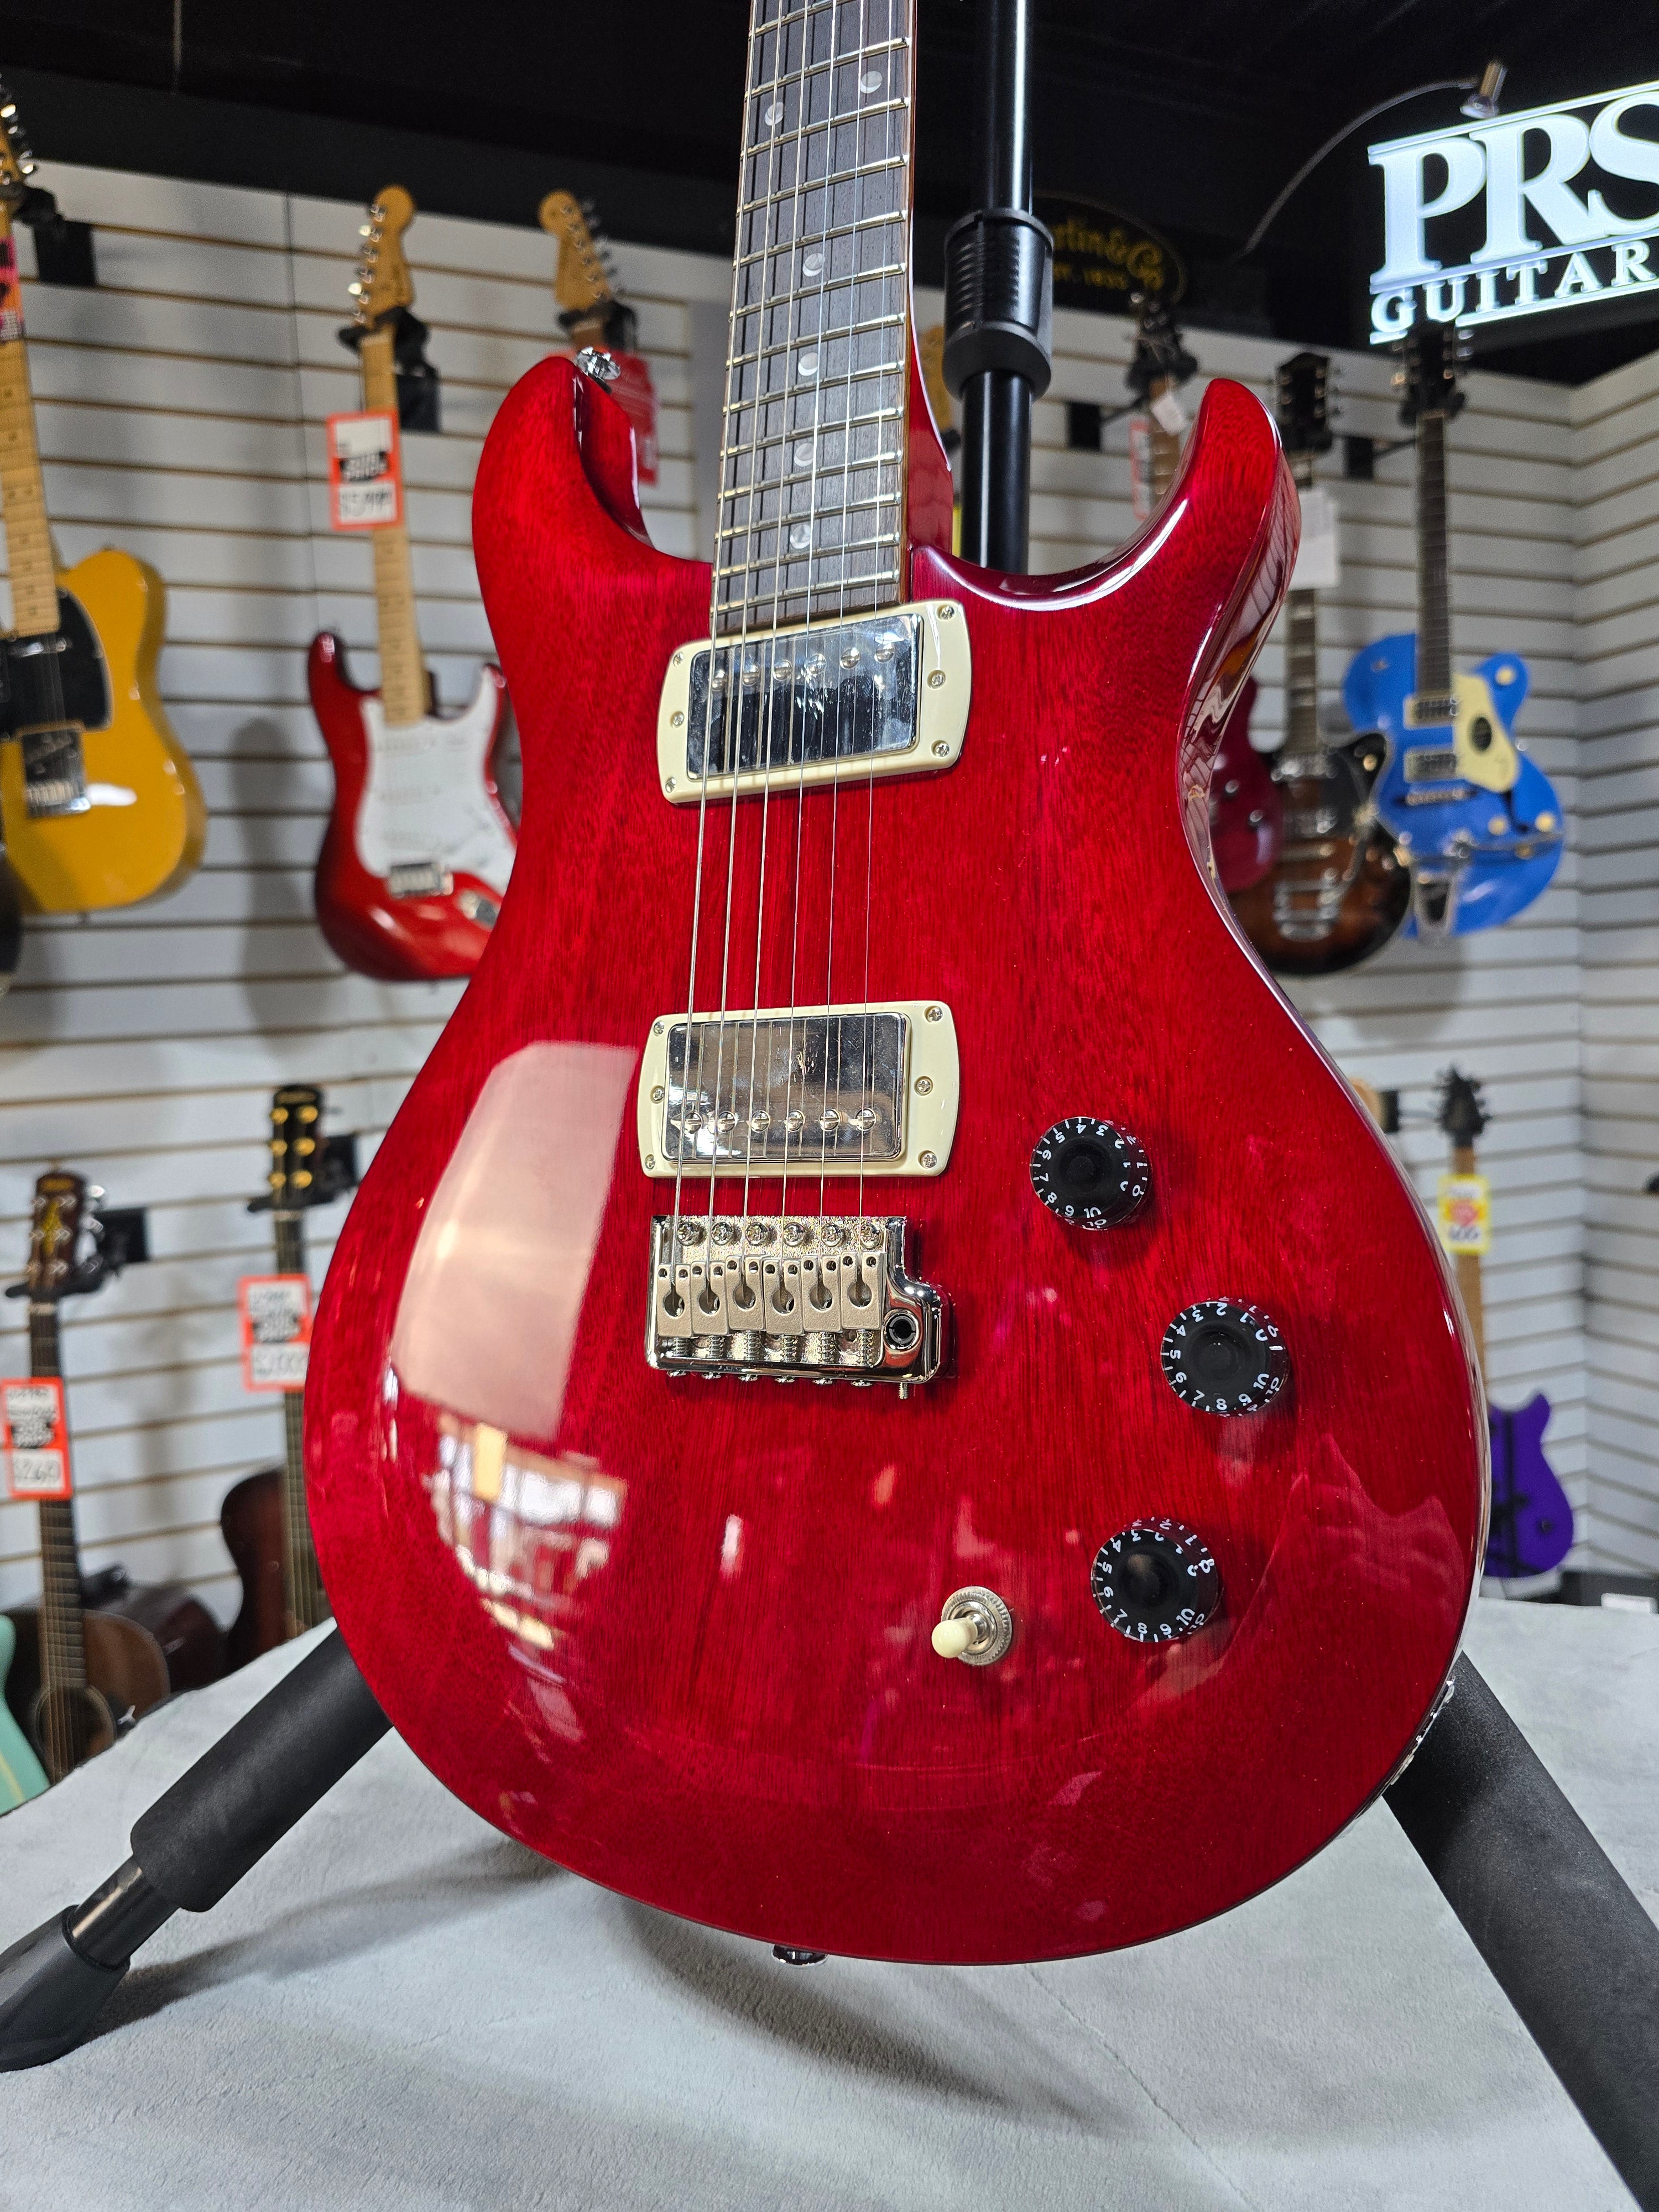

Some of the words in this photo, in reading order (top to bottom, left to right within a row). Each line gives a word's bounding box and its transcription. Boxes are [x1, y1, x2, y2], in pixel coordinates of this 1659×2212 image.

[1369, 91, 1659, 283] PRS
[1076, 1123, 1086, 1134] 4
[1096, 1125, 1108, 1136] 3
[1055, 1132, 1065, 1143] 5
[1042, 1150, 1051, 1160] 6
[1040, 1172, 1049, 1182] 7
[1047, 1192, 1057, 1203] 8
[1065, 1205, 1074, 1217] 9
[1083, 1207, 1102, 1218] 10
[1217, 1303, 1228, 1316] 2
[1192, 1310, 1204, 1322] 3
[1240, 1312, 1249, 1323] 1
[1176, 1325, 1186, 1336] 4
[1170, 1349, 1181, 1359] 5
[1176, 1372, 1187, 1383] 6
[1253, 1373, 1270, 1390] 10
[1193, 1390, 1205, 1401] 7
[1238, 1393, 1252, 1405] 9
[1216, 1398, 1227, 1410] 8
[1131, 1530, 1141, 1542] 3
[1113, 1540, 1121, 1552] 4
[1102, 1562, 1112, 1574] 5
[1103, 1586, 1113, 1597] 6
[1117, 1608, 1128, 1618] 7
[1176, 1608, 1196, 1626] 10
[1138, 1623, 1147, 1634] 8
[1160, 1623, 1172, 1635] 9
